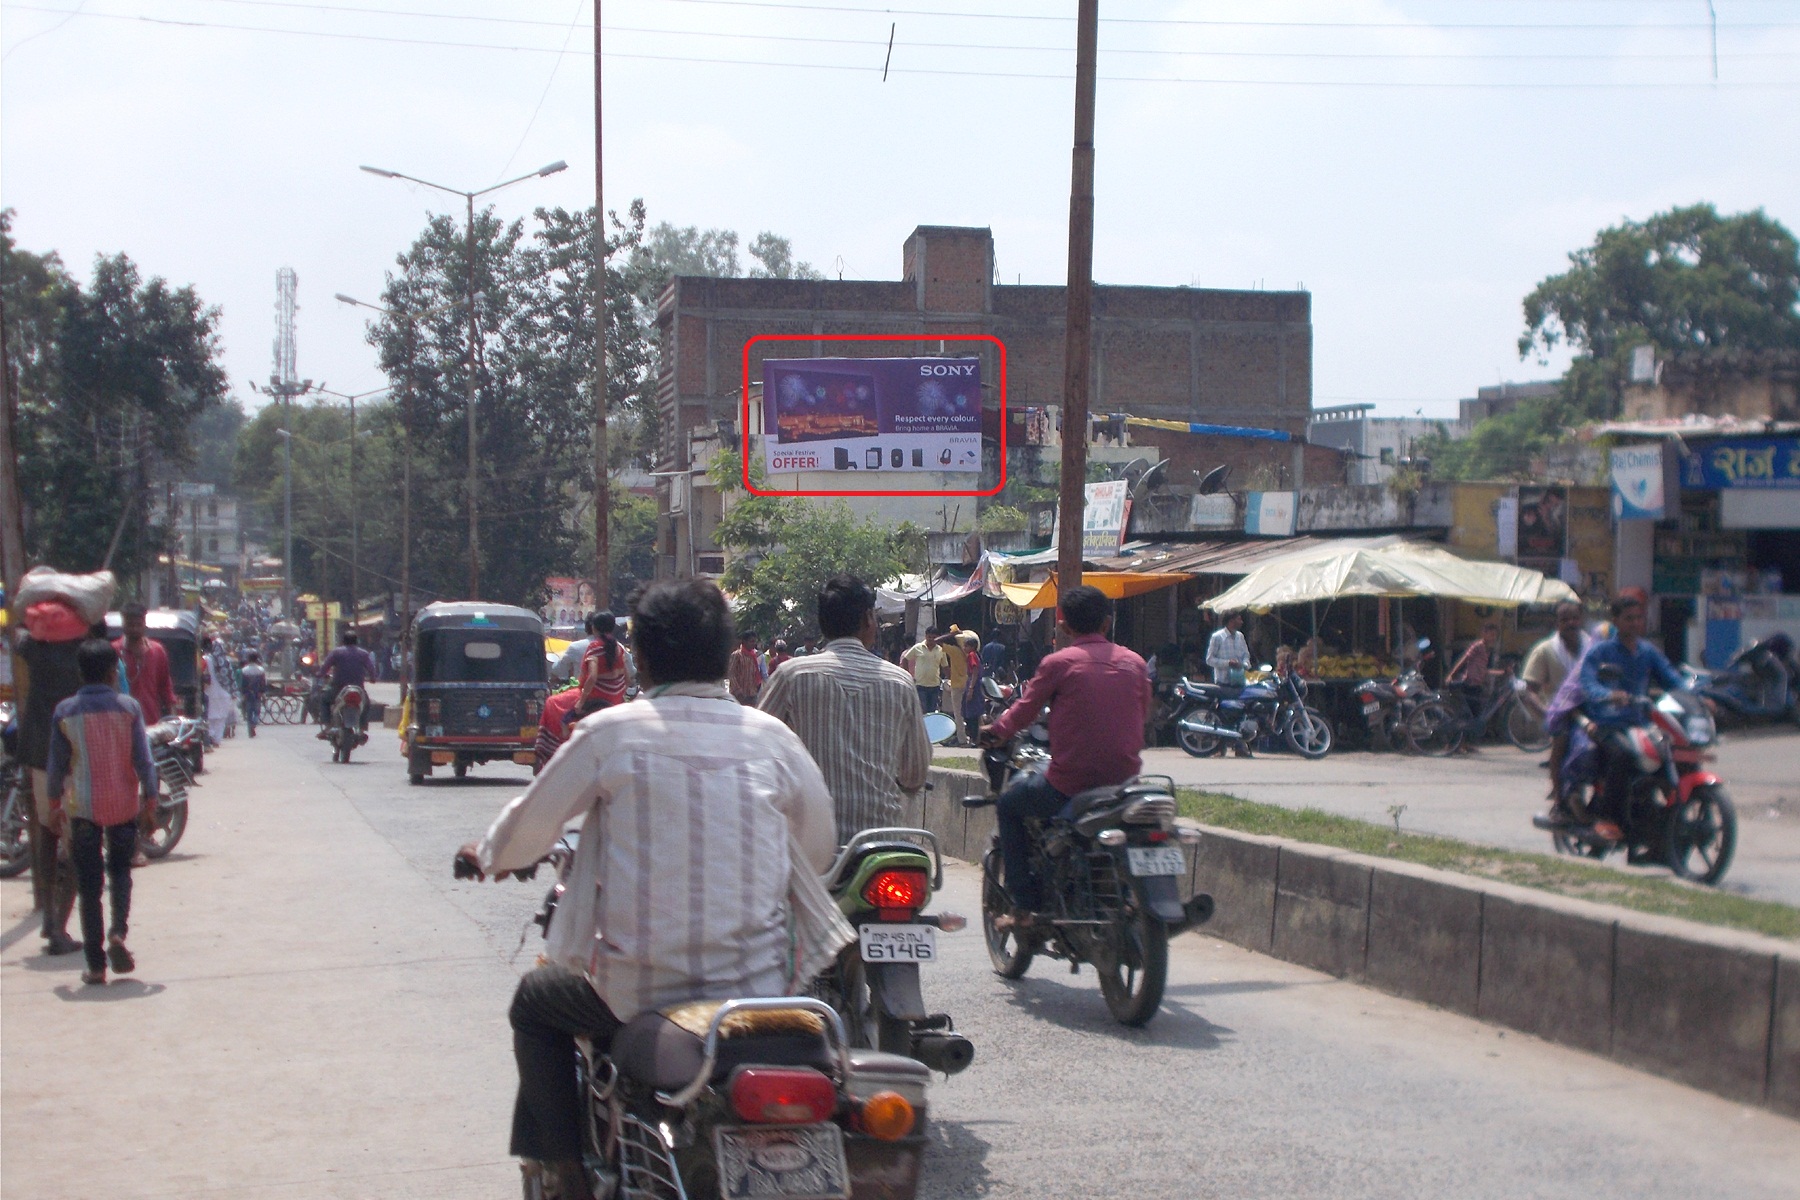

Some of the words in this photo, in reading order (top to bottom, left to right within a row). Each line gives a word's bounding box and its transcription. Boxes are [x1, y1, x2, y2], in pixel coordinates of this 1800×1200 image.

[920, 365, 976, 376] SONY
[895, 414, 926, 424] Respect
[927, 415, 949, 424] every
[950, 414, 977, 423] colour.
[895, 424, 911, 432] Bring
[772, 457, 819, 468] OFFER!
[867, 943, 931, 958] 6146
